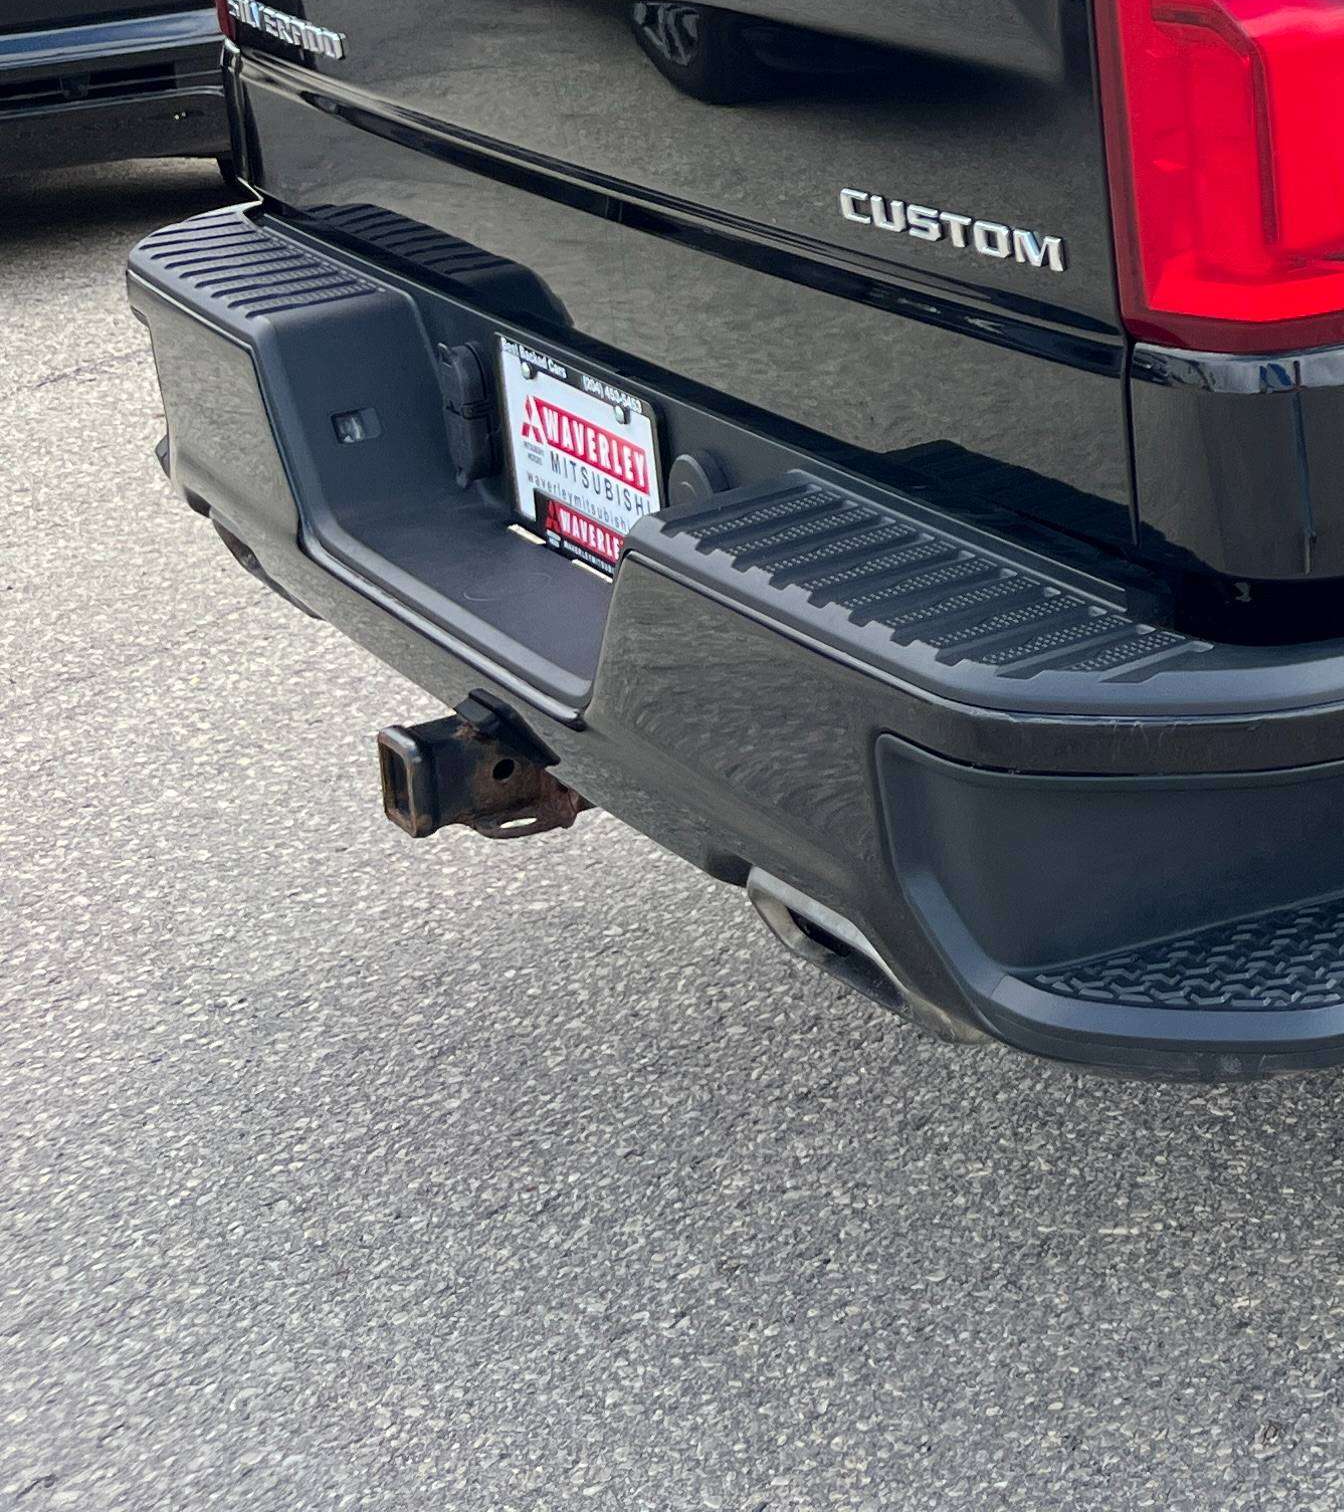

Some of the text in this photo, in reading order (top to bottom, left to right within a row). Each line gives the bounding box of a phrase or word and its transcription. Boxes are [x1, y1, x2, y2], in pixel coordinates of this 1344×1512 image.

[840, 188, 1065, 272] CUSTOM
[543, 405, 646, 489] WAVERLEY
[550, 450, 651, 516] MITSUBISHI
[559, 506, 622, 562] WAVERLE
